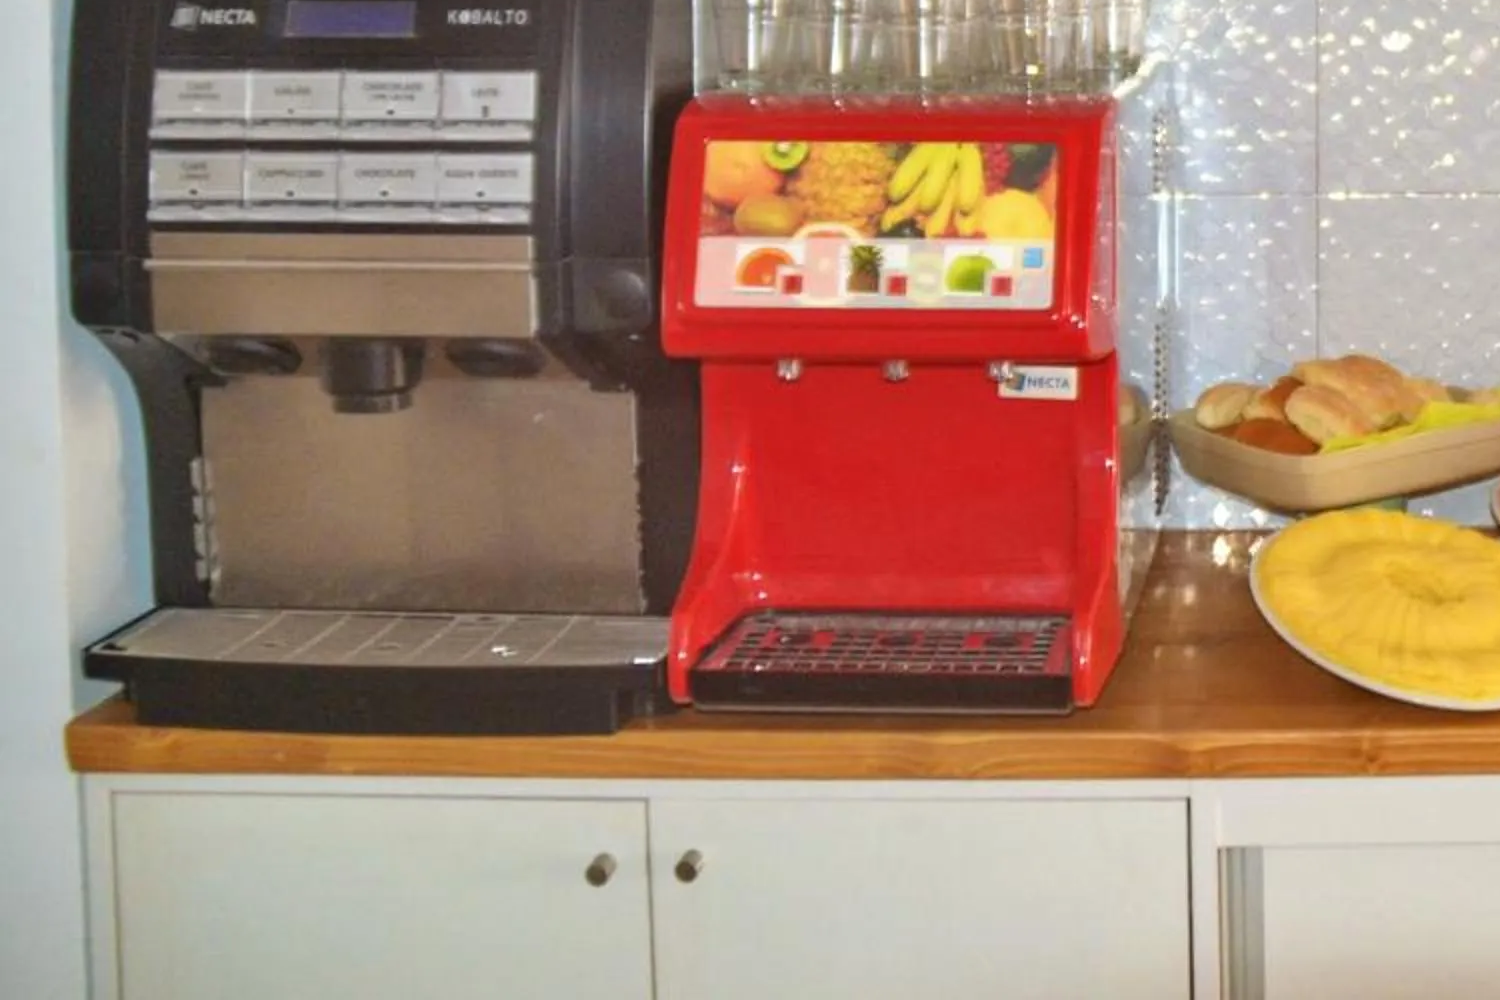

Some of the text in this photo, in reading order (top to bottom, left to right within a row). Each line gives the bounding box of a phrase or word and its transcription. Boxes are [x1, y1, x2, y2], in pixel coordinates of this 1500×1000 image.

[200, 8, 256, 25] NECTA
[447, 8, 529, 25] KOBALTO
[1026, 375, 1070, 389] NECTA
